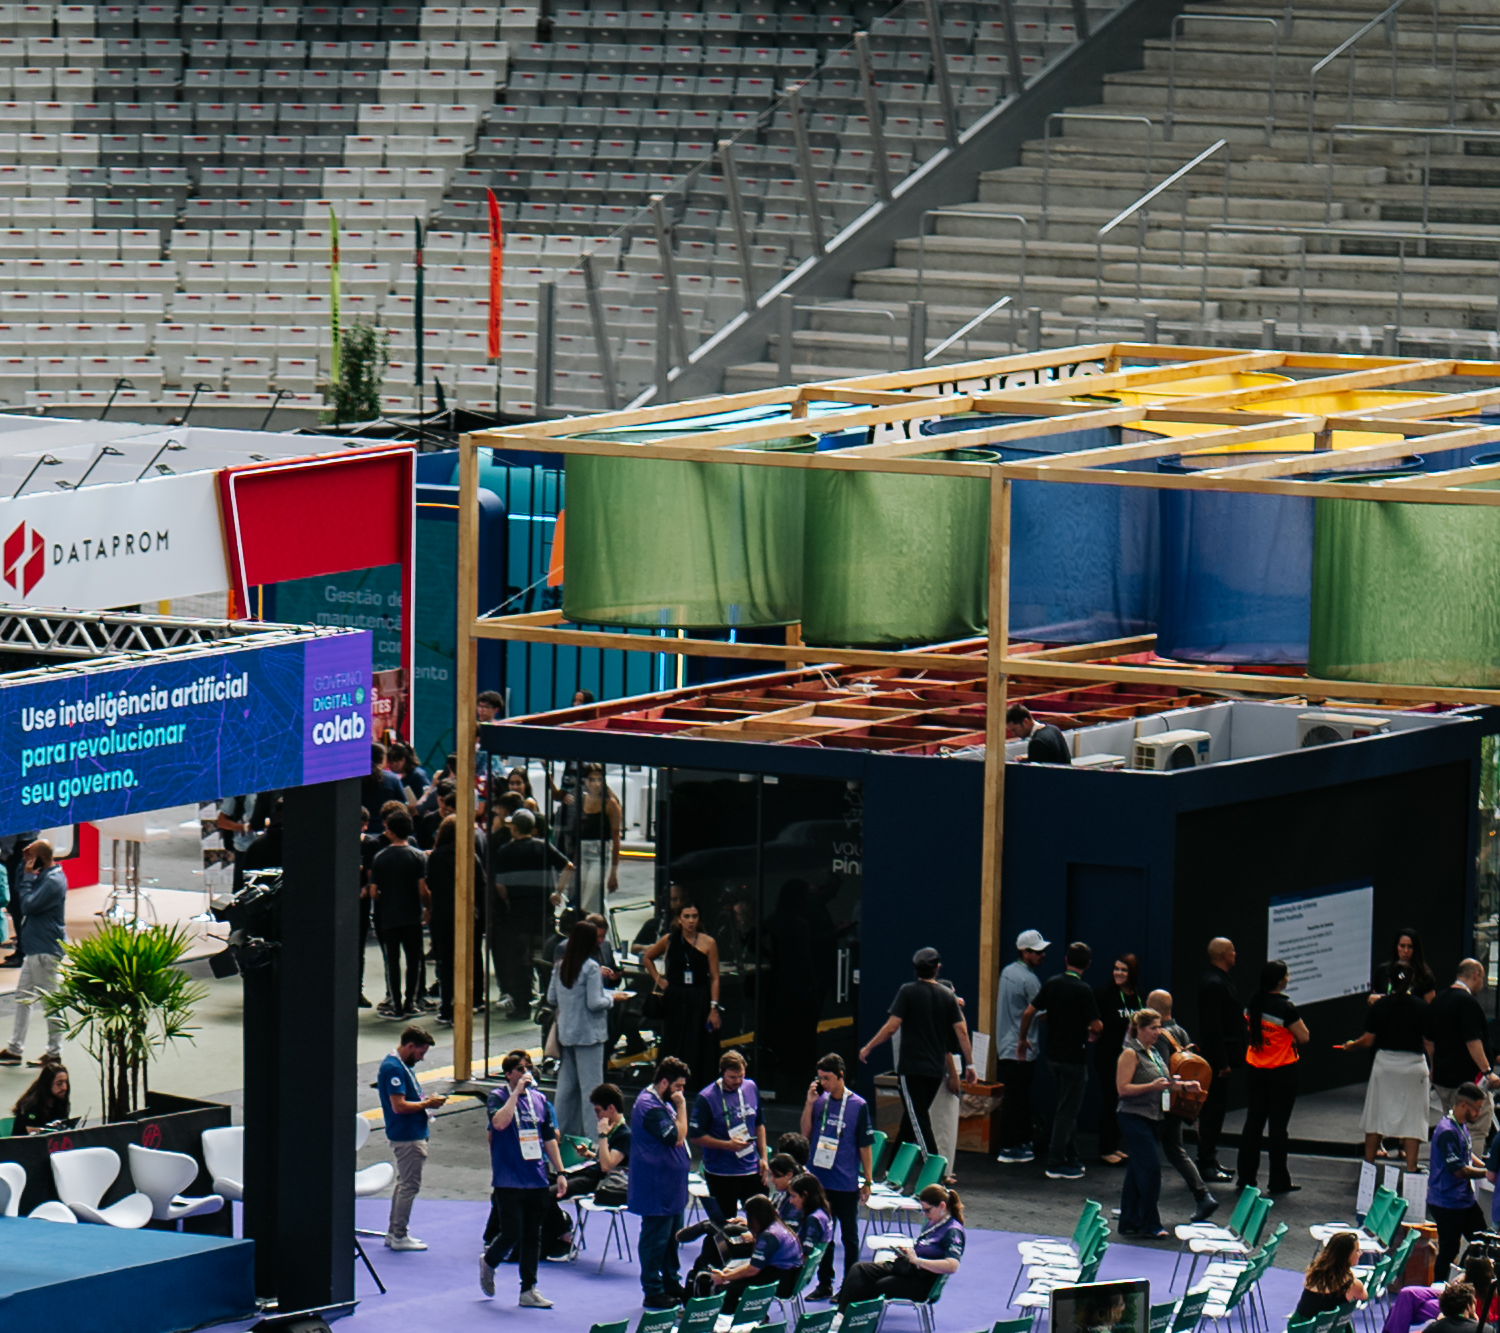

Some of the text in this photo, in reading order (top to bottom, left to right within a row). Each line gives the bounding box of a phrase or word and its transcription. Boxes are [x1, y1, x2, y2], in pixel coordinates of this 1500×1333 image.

[52, 530, 170, 566] DATAPROM
[325, 585, 382, 606] Gestão
[21, 672, 248, 733] Use inteligência artificial
[313, 696, 353, 712] DIGITAL
[21, 720, 186, 770] para revolucionar
[312, 712, 365, 746] colab
[21, 768, 138, 807] seu governo.
